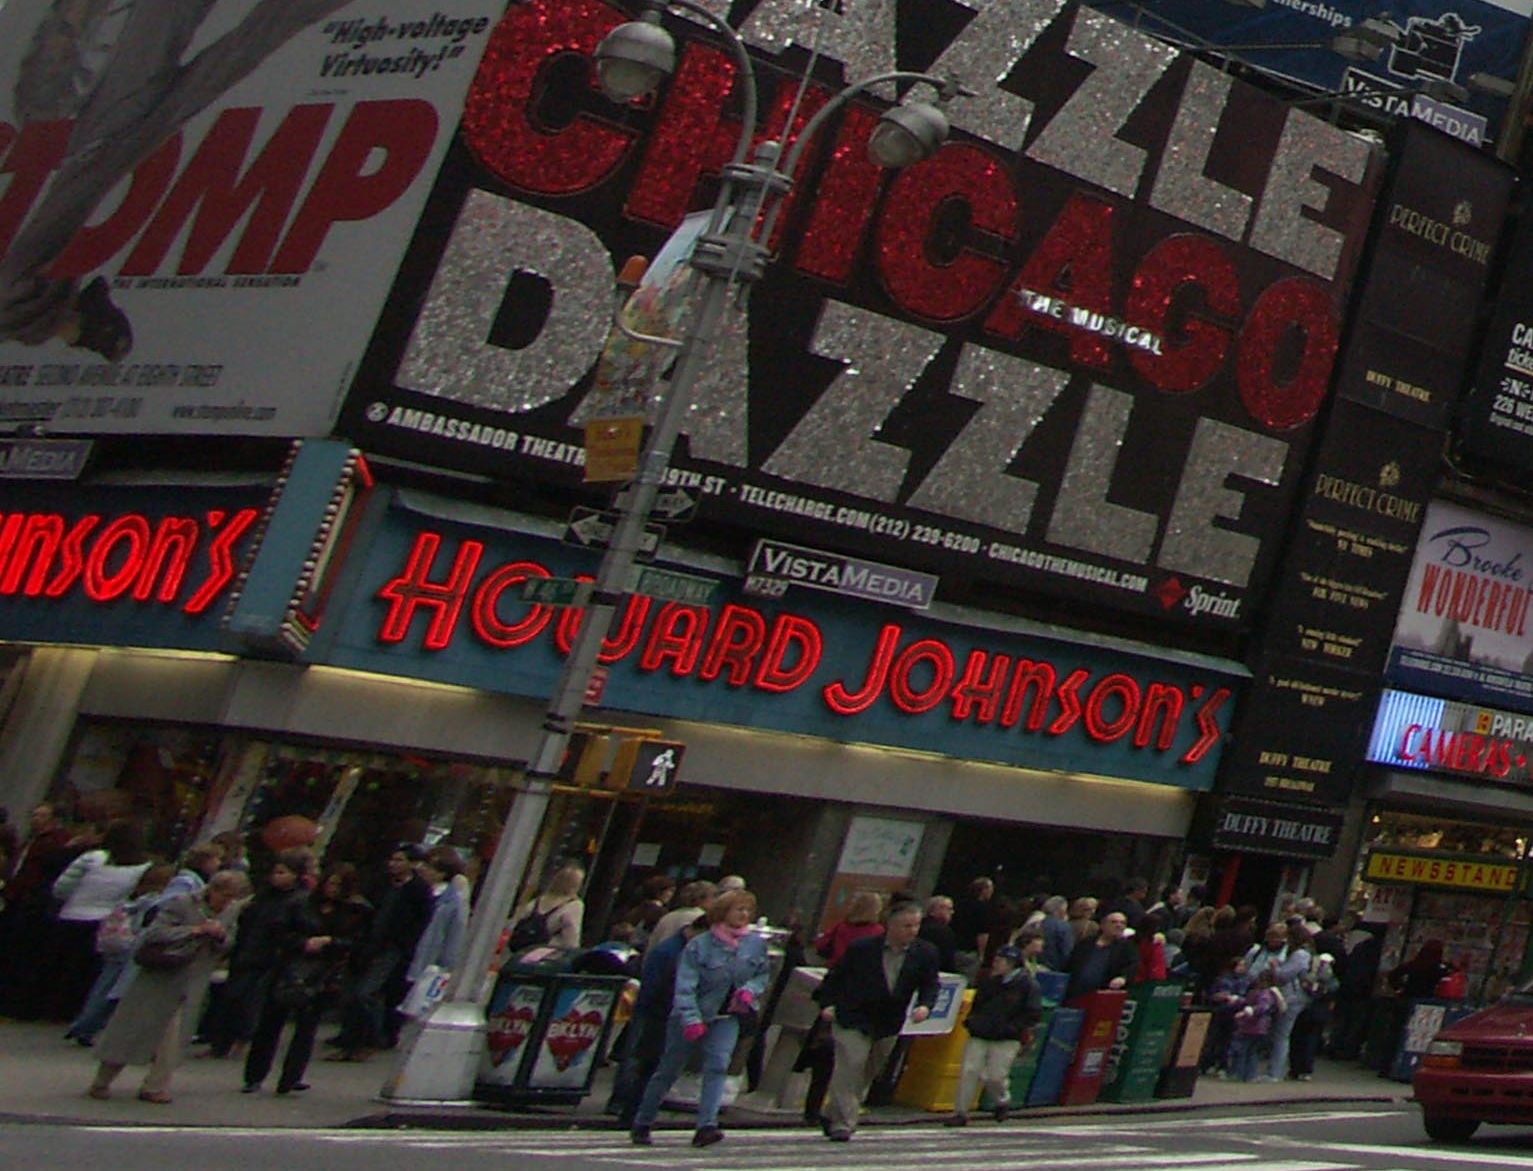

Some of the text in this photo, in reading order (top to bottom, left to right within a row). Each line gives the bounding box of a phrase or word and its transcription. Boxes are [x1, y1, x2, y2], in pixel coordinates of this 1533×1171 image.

[1018, 287, 1164, 356] THE MUSICAL
[1430, 526, 1523, 582] Brooke
[1184, 586, 1242, 620] Sprint
[1417, 561, 1533, 639] WONDERFUL
[379, 531, 824, 694] HOWARD
[823, 625, 1233, 765] JOHNSON'S
[1399, 723, 1512, 779] CAMERAS
[1222, 810, 1332, 847] DUFFY THEATRE
[1380, 856, 1520, 888] NEWSSTAND
